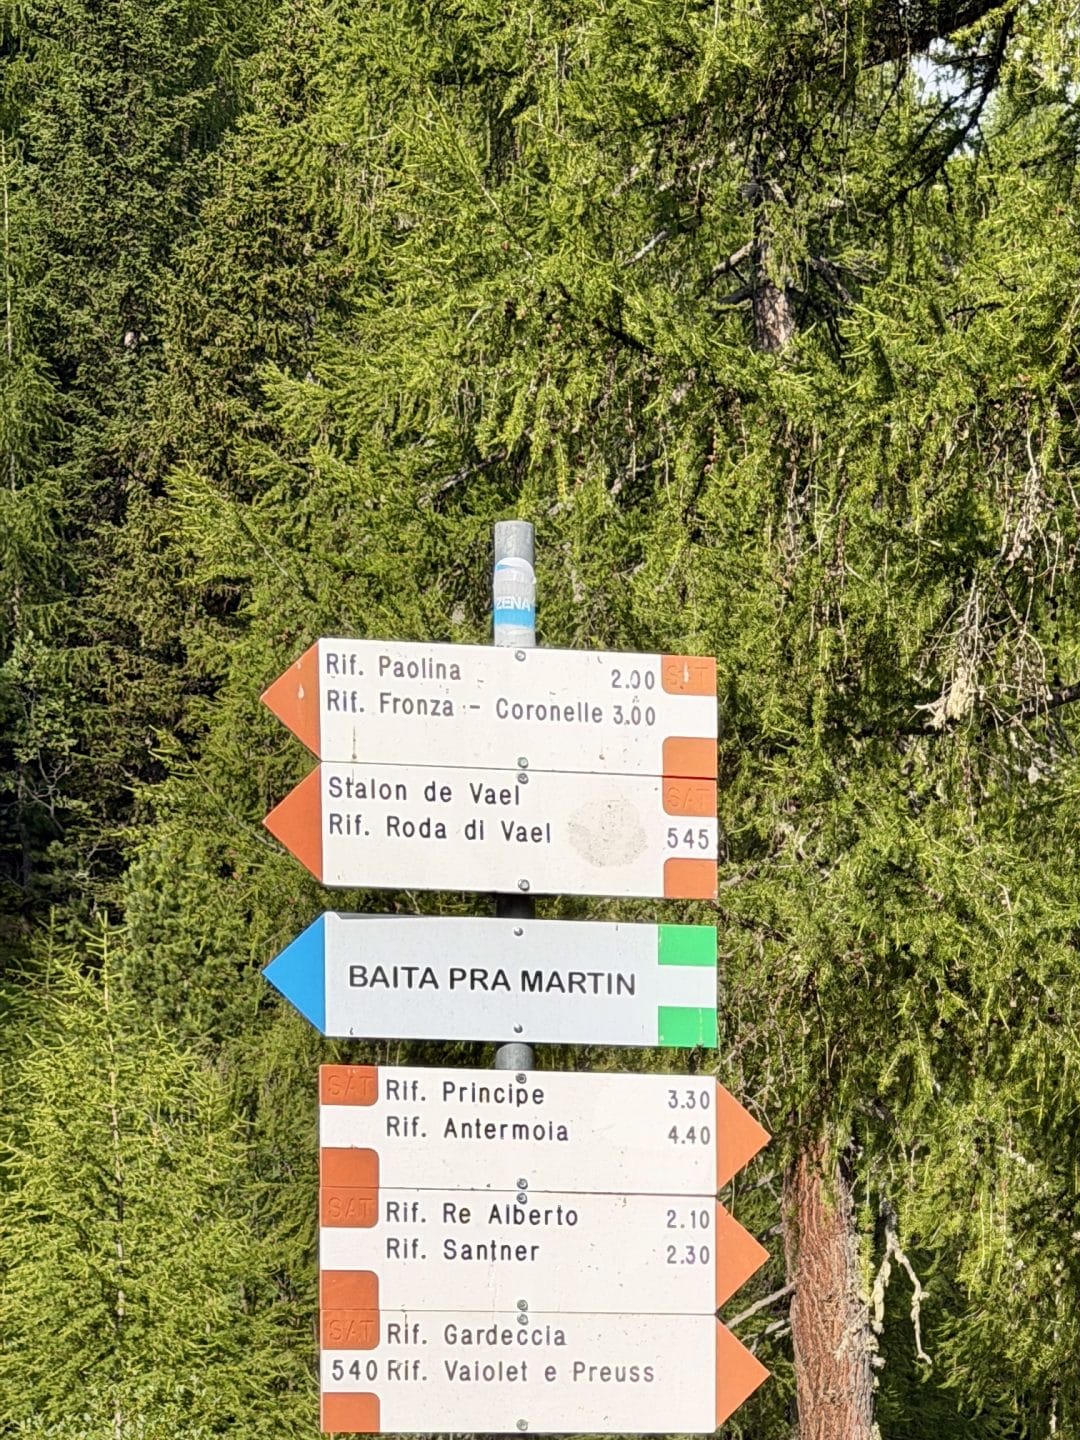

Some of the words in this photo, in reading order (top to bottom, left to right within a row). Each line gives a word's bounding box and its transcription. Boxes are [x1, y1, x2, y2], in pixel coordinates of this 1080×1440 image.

[326, 653, 364, 676] Rif.
[379, 655, 461, 681] Paolina
[611, 669, 655, 690] 2.00
[327, 689, 365, 713] Rif.
[379, 692, 454, 717] Fronza
[496, 697, 603, 724] Coronelle
[613, 705, 656, 726] 3.00
[328, 776, 407, 801] Stalon
[423, 780, 452, 803] de
[469, 782, 520, 806] Vael
[329, 813, 370, 836] Rif.
[386, 815, 447, 840] Roda
[464, 818, 484, 841] di
[500, 820, 551, 844] Vael
[667, 827, 709, 850] 545
[349, 965, 440, 990] BAITA
[449, 967, 512, 992] PRA
[520, 969, 635, 996] MARTIN
[386, 1078, 426, 1102] Rif.
[442, 1079, 545, 1108] Principe
[668, 1089, 710, 1110] 3.30
[386, 1115, 427, 1138] Rif.
[443, 1117, 569, 1142] Antermoia
[668, 1125, 711, 1145] 4.40
[386, 1201, 426, 1223] Rif.
[443, 1202, 471, 1225] Re
[488, 1202, 578, 1227] Alberto
[667, 1209, 710, 1229] 2.10
[386, 1237, 427, 1260] Rif.
[443, 1238, 540, 1262] Santner
[667, 1244, 710, 1265] 2.30
[387, 1323, 427, 1345] Rif.
[444, 1321, 567, 1346] Gardeccia
[332, 1359, 378, 1381] 540
[387, 1359, 427, 1381] Rif.
[444, 1360, 528, 1382] Vaiolet
[544, 1365, 557, 1382] e
[573, 1361, 654, 1383] Preuss
